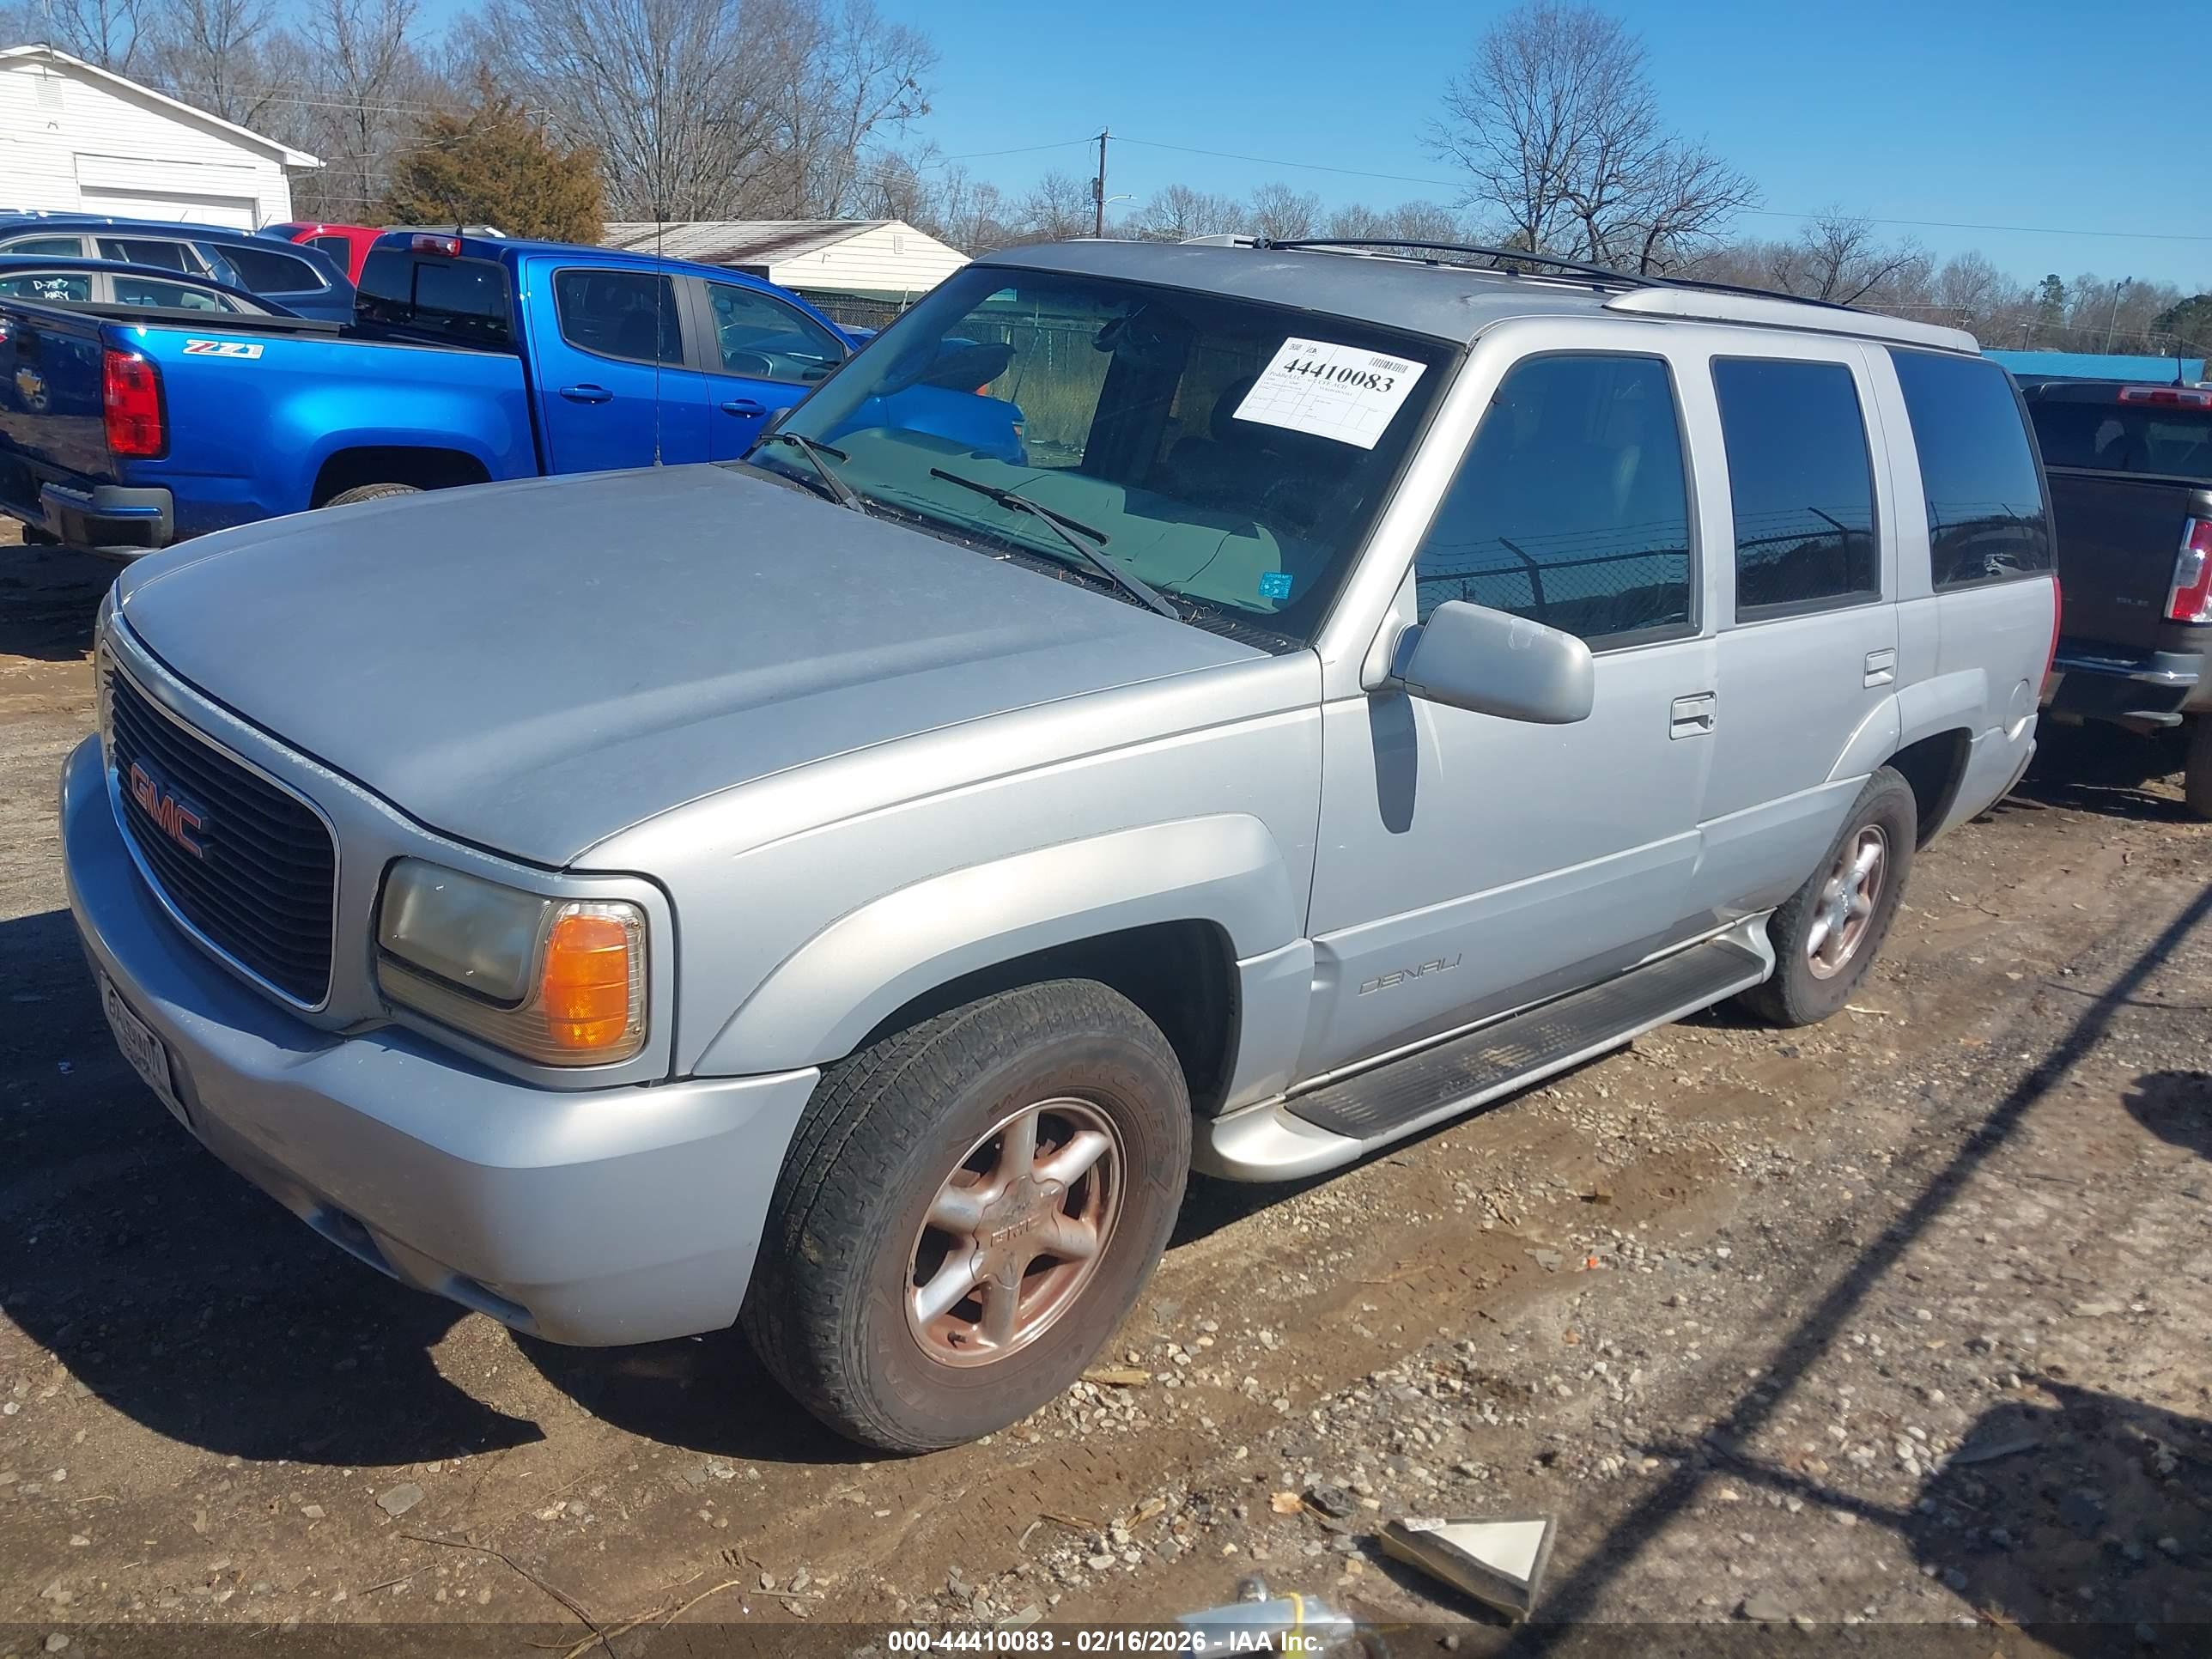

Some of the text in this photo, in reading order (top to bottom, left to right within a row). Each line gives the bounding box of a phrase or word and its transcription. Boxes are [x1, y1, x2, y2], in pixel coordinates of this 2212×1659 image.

[183, 339, 264, 359] Z71
[1284, 359, 1395, 392] 44410083
[131, 762, 204, 860] GMC
[1358, 953, 1462, 997] DENALI
